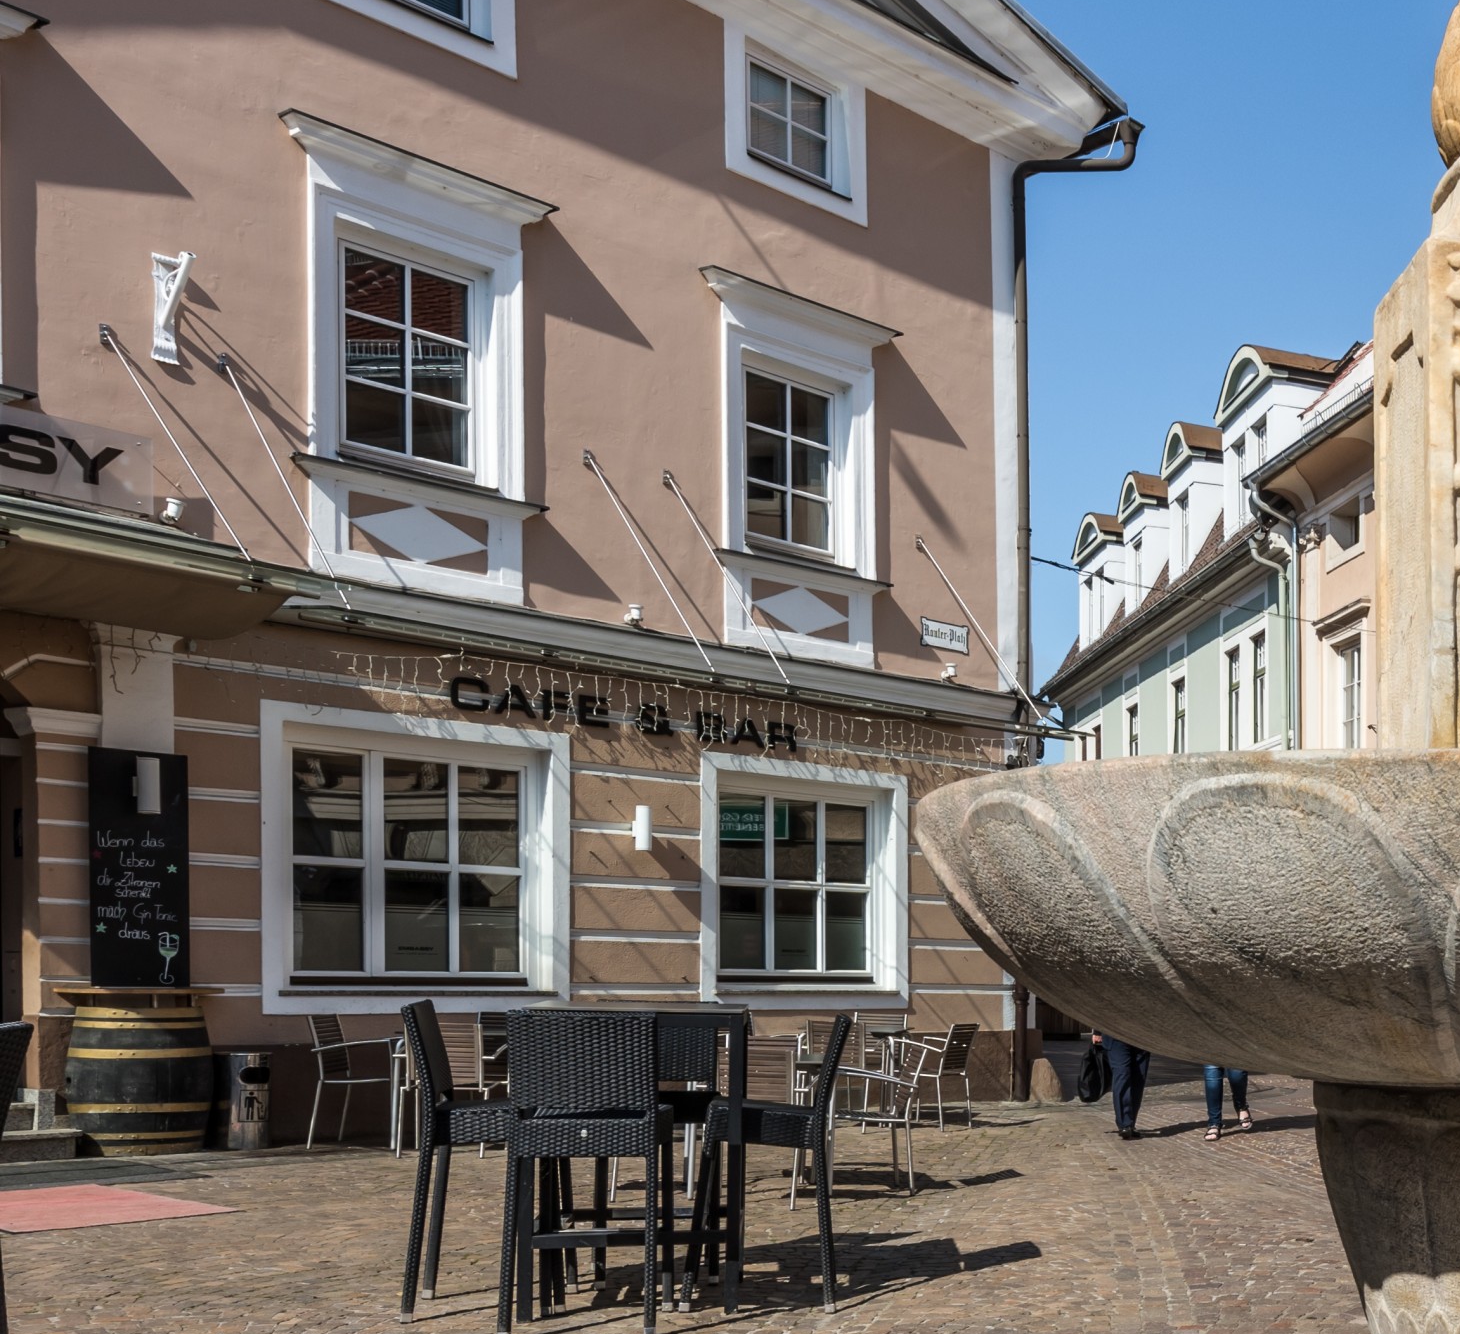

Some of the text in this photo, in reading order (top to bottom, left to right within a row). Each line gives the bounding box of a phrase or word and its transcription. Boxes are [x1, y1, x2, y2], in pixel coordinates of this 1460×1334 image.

[696, 711, 797, 752] BAR
[97, 830, 165, 847] Wenn das
[97, 868, 113, 886] dir
[97, 901, 126, 921] mach
[133, 903, 151, 924] Gin
[118, 922, 150, 940] draus
